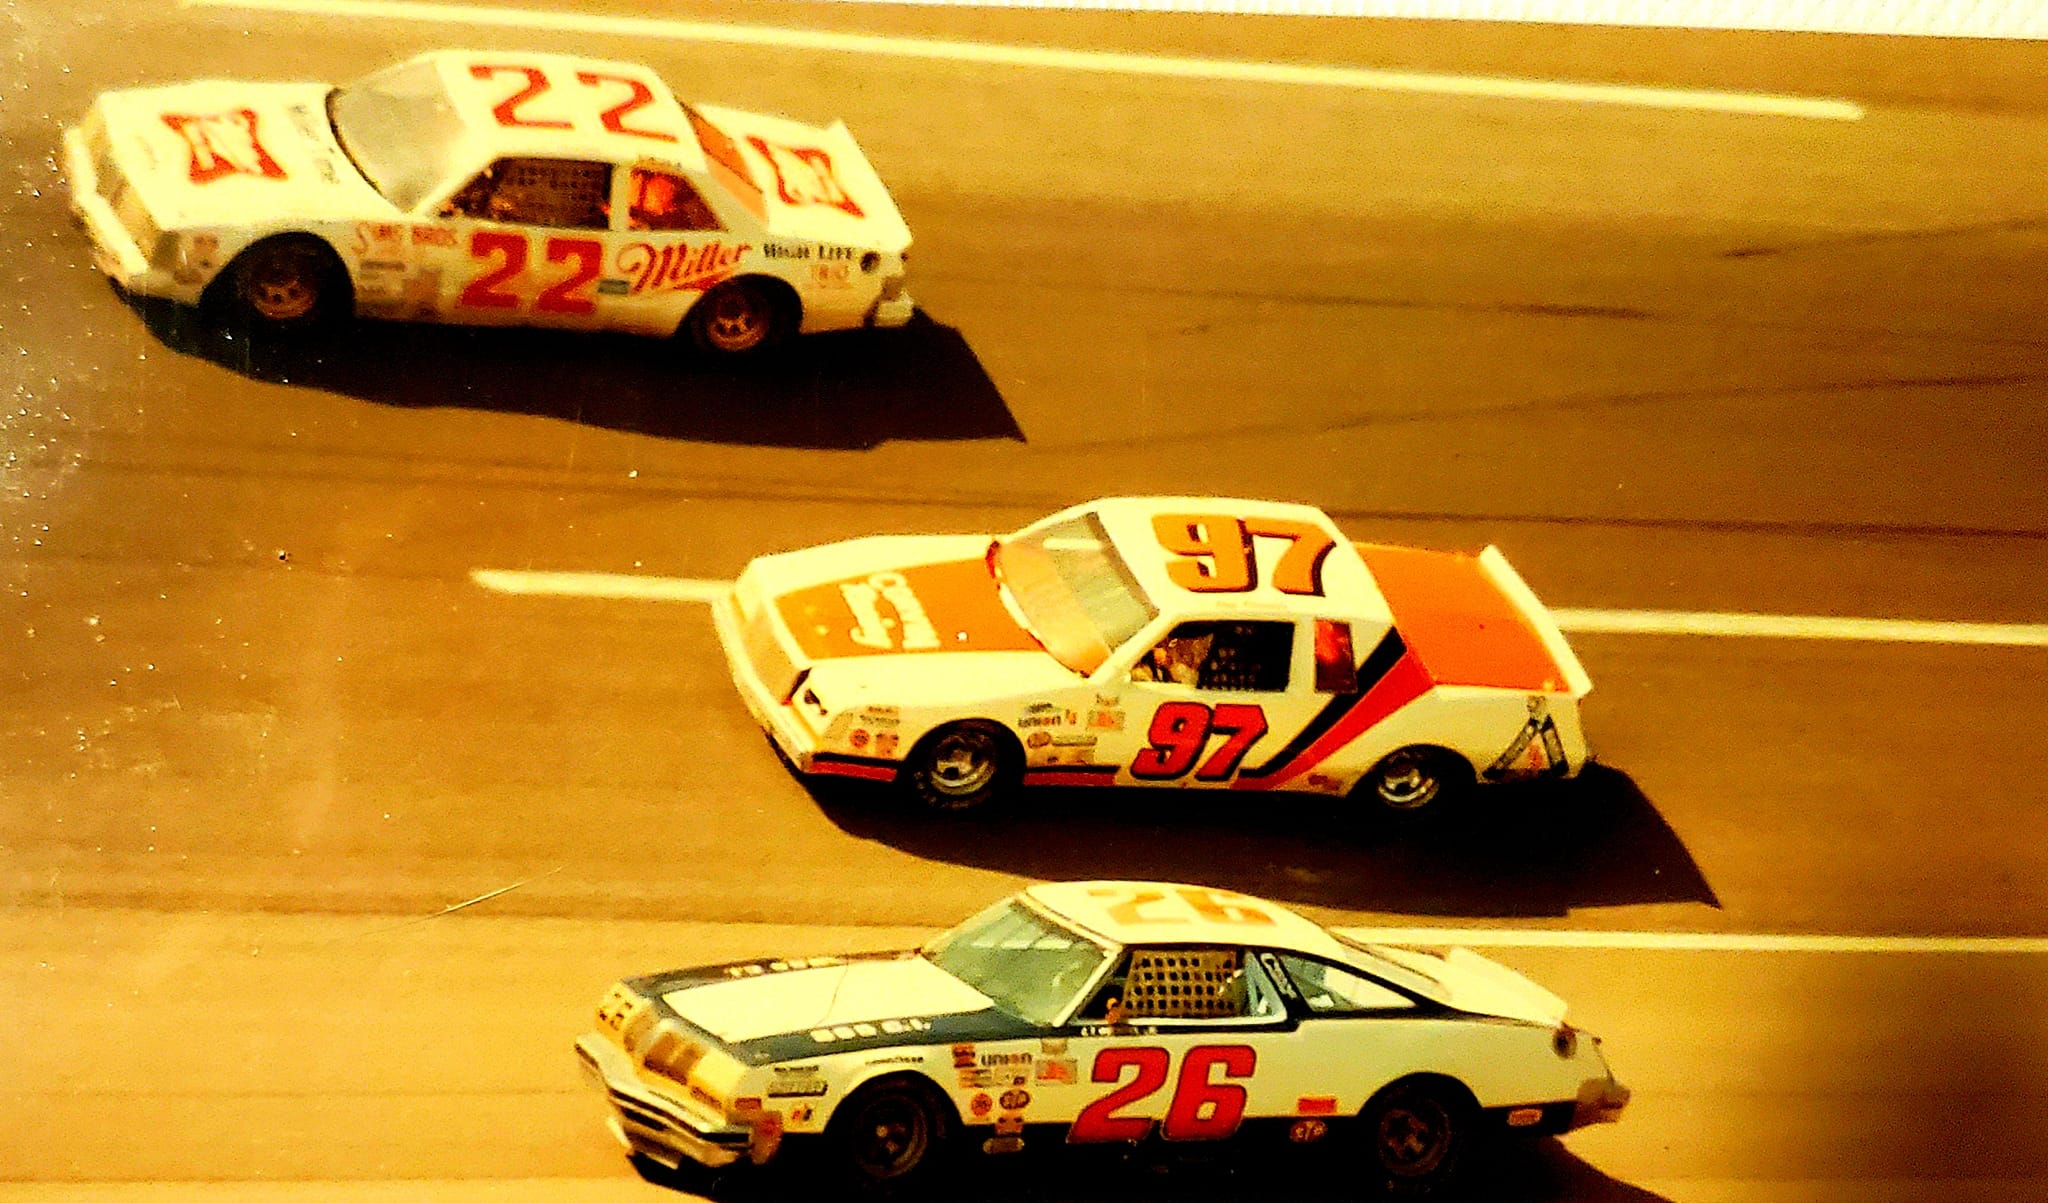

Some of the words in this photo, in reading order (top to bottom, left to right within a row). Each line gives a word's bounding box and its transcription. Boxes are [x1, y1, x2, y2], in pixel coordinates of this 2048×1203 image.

[468, 64, 679, 143] 22
[458, 231, 604, 315] 22
[616, 240, 752, 295] Miller
[1151, 512, 1337, 598] 97
[1130, 701, 1269, 782] 97
[1085, 886, 1278, 927] 26
[1065, 1044, 1258, 1144] 26
